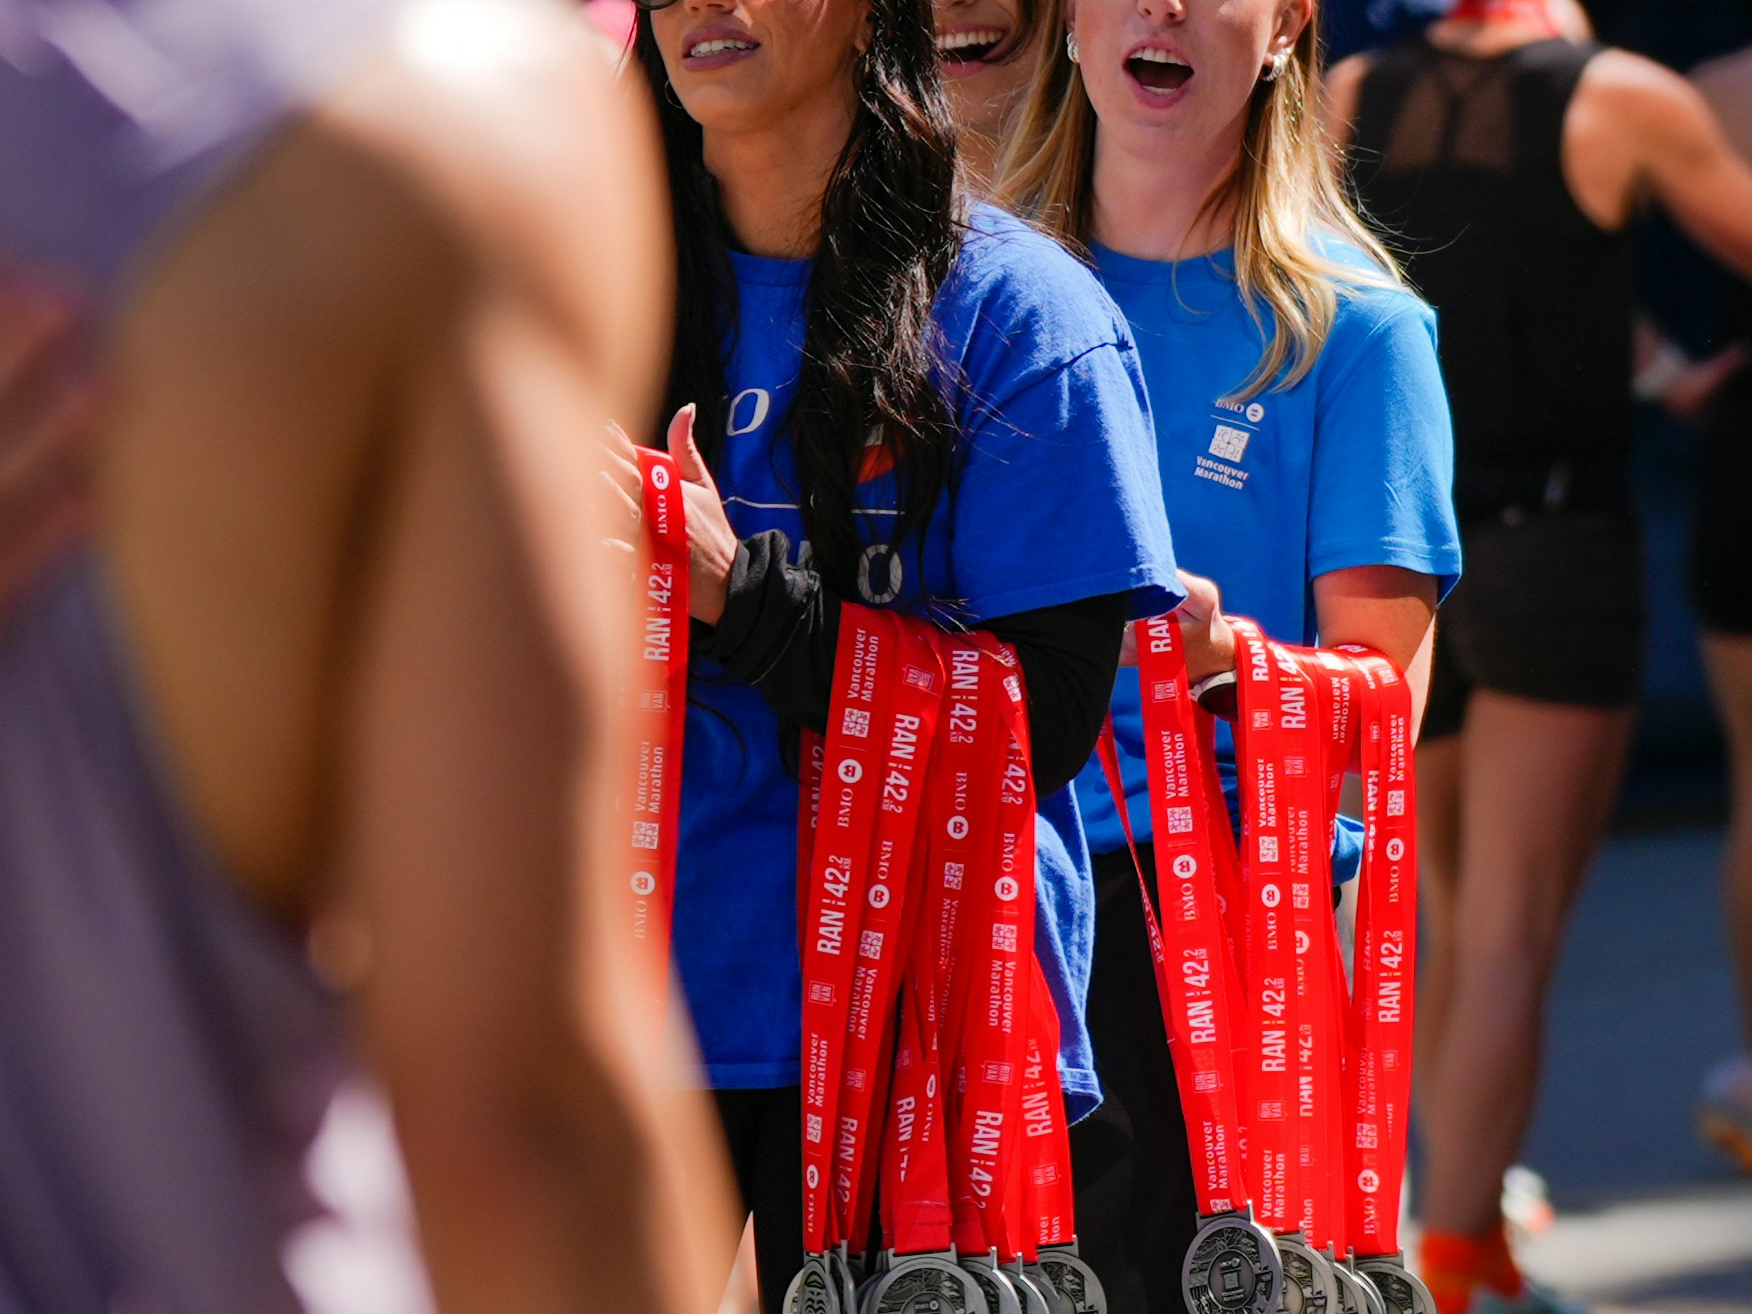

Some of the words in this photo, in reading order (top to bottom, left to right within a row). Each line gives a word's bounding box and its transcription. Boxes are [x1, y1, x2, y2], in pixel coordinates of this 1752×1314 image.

[1194, 467, 1244, 490] Marathon
[1196, 456, 1249, 480] Vancouver
[656, 493, 668, 535] BMO
[644, 616, 671, 662] RAN
[1250, 641, 1270, 682] RAN
[847, 628, 867, 699] Vancouver
[861, 635, 879, 702] Marathon
[951, 650, 979, 690] RAN
[1281, 687, 1306, 729] RAN
[889, 713, 921, 760] RAN
[634, 740, 650, 812] Vancouver
[648, 746, 664, 814] Marathon
[1161, 730, 1173, 800] Vancouver
[1174, 733, 1189, 798] Marathon
[837, 788, 854, 828] BMO
[954, 772, 967, 811] BMO
[1257, 758, 1266, 828] Vancouver
[1266, 762, 1277, 827] Marathon
[877, 840, 893, 880] BMO
[1002, 833, 1015, 872] BMO
[1180, 883, 1197, 922] BMO
[1389, 865, 1399, 903] BMO
[817, 909, 845, 956] RAN
[1267, 911, 1277, 951] BMO
[848, 966, 866, 1032] Marathon
[857, 968, 878, 1040] Vancouver
[989, 959, 1002, 1027] Marathon
[1001, 961, 1016, 1034] Vancouver
[1378, 981, 1401, 1023] RAN
[1190, 1001, 1217, 1044] RAN
[807, 1032, 819, 1104] Vancouver
[815, 1039, 828, 1107] Marathon
[1261, 1029, 1285, 1072] RAN
[971, 1110, 1003, 1155] RAN
[1022, 1090, 1053, 1138] RAN
[839, 1116, 858, 1162] RAN
[1202, 1120, 1218, 1191] Vancouver
[1215, 1124, 1229, 1189] Marathon
[1260, 1148, 1272, 1219] Vancouver
[1274, 1153, 1285, 1218] Marathon
